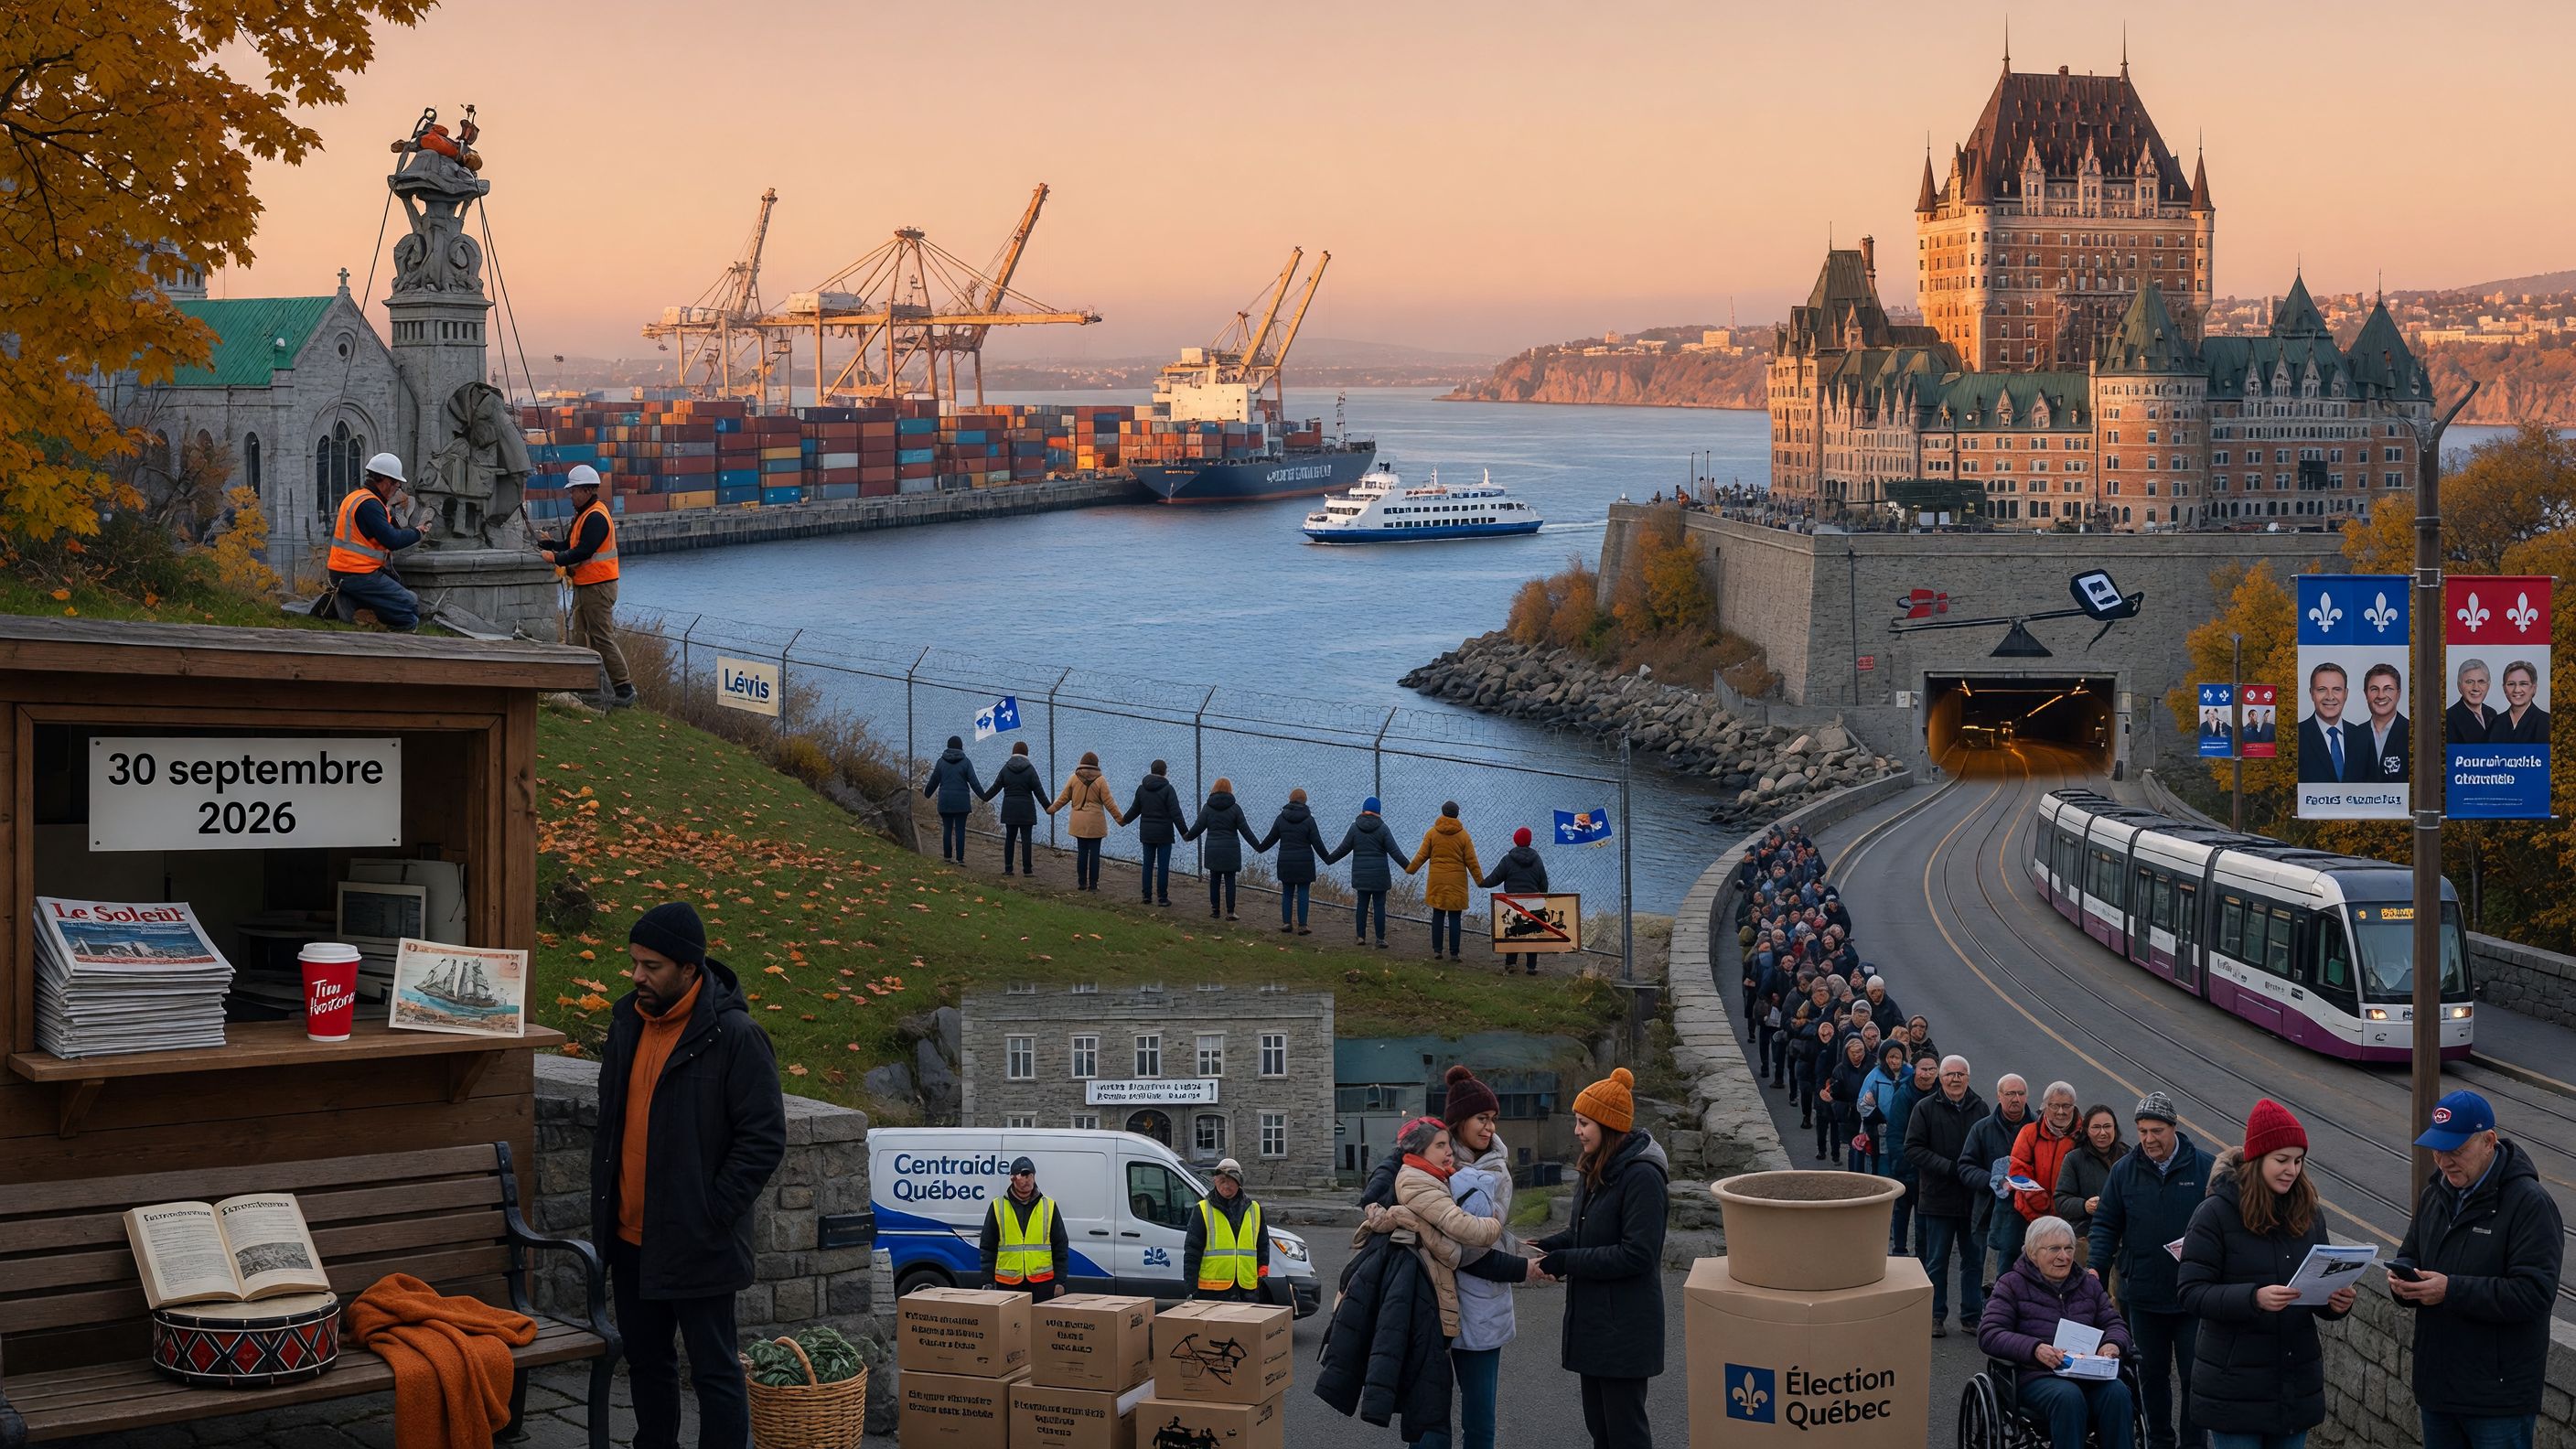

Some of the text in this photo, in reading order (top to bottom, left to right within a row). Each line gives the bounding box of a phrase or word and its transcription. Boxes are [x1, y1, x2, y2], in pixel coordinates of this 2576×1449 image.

[724, 668, 769, 699] Lévis
[108, 750, 383, 794] 30 septembre
[198, 801, 296, 834] 2026
[50, 902, 91, 919] Le
[894, 1154, 1011, 1175] Centraide
[893, 1178, 985, 1203] Québec
[1786, 1365, 1894, 1396] Élection
[1786, 1400, 1891, 1432] Québec
